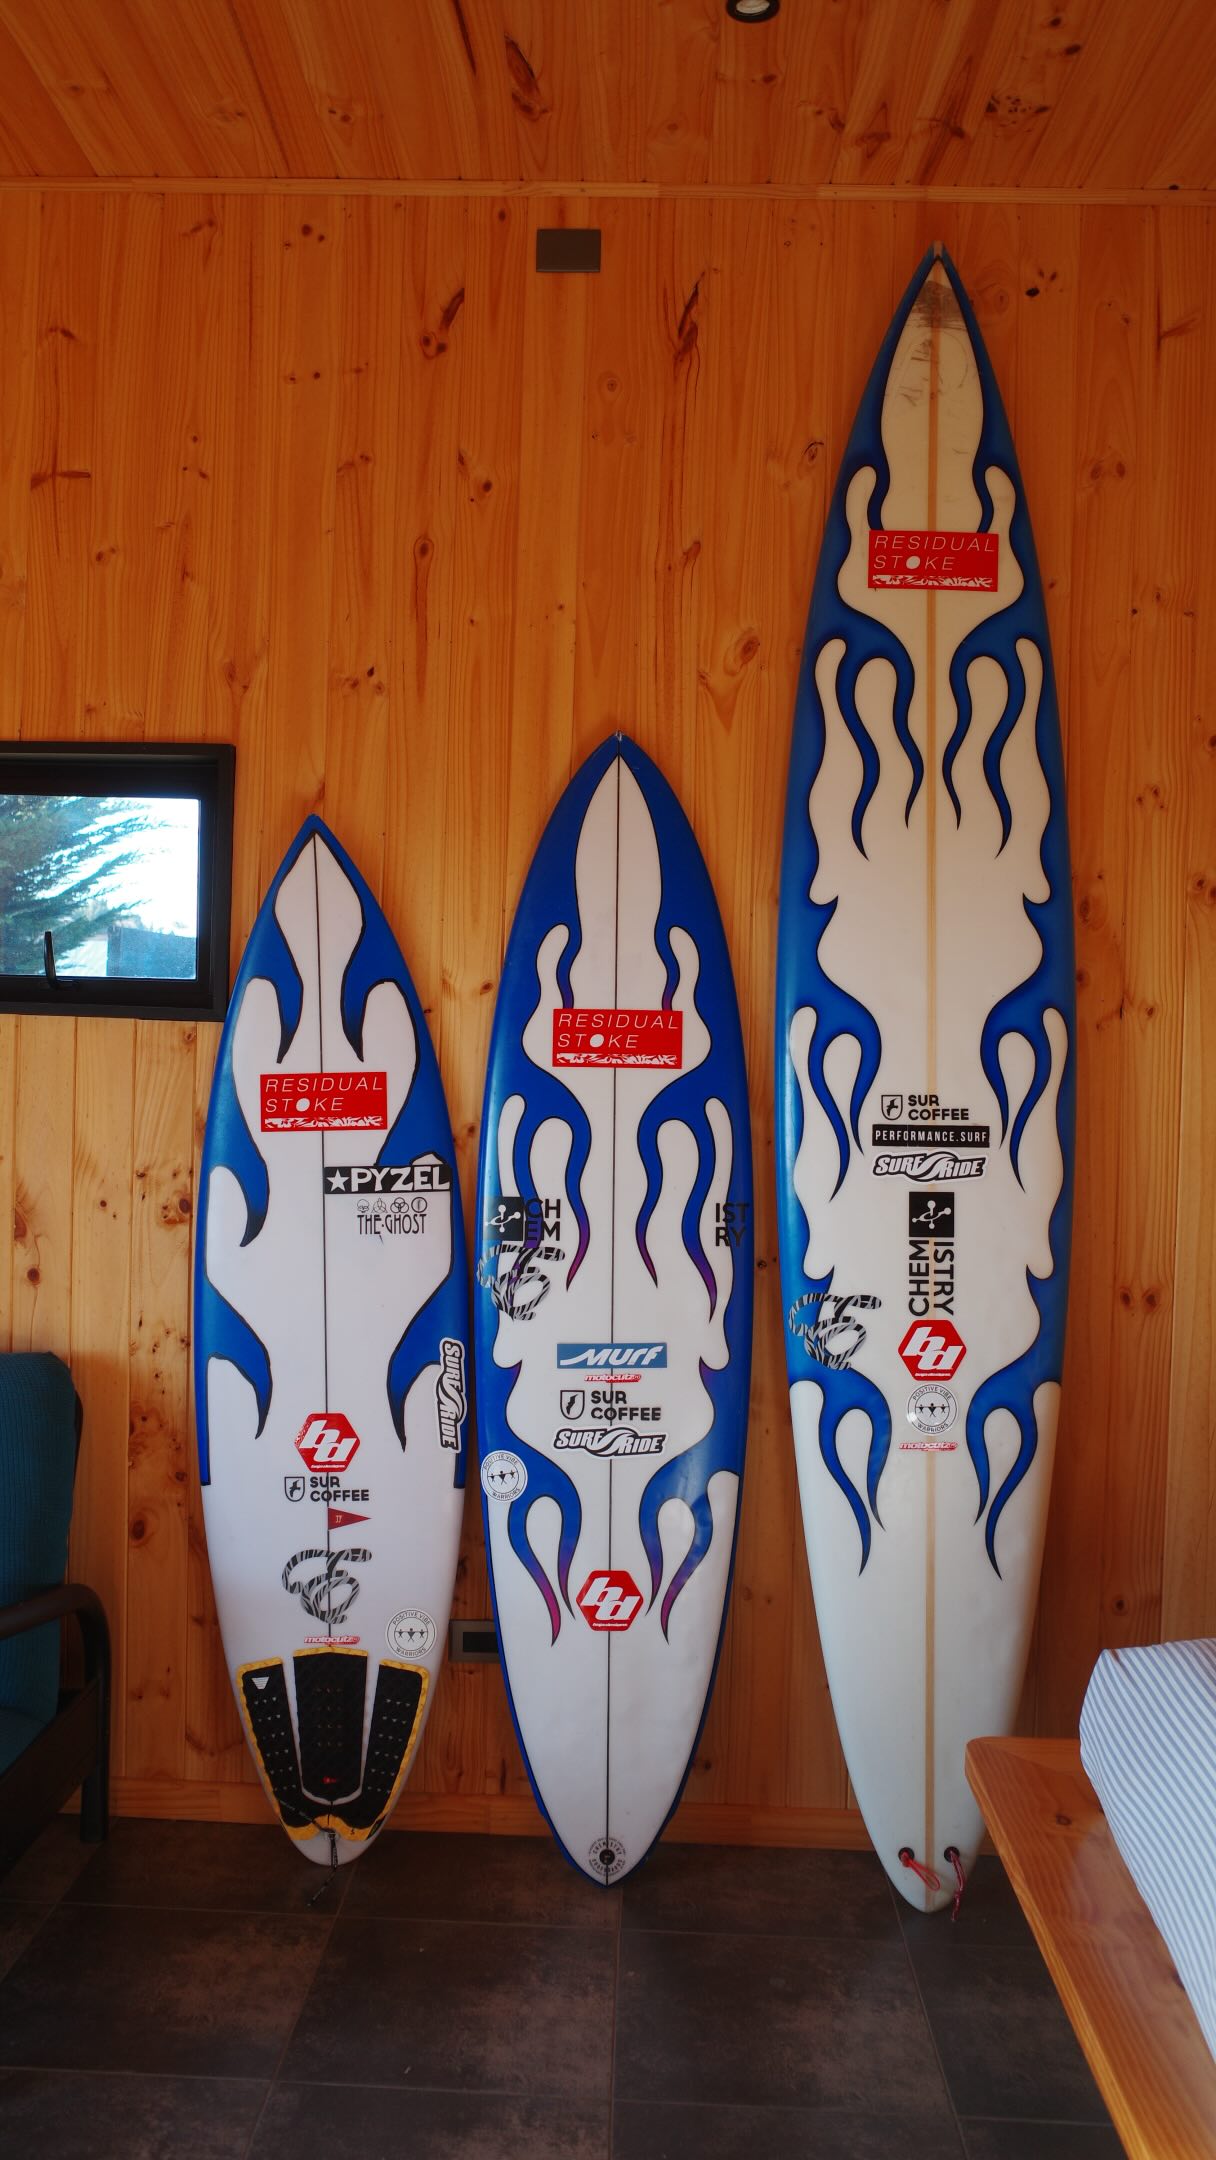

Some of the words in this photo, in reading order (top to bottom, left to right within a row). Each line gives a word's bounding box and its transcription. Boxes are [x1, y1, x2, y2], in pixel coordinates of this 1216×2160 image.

[874, 535, 994, 552] RESIDUAL
[873, 555, 955, 571] STOKE
[558, 1013, 679, 1030] RESIDUAL
[557, 1033, 640, 1049] STOKE
[265, 1076, 383, 1093] RESIDUAL
[265, 1097, 344, 1113] STOKE
[908, 1094, 939, 1107] SUR
[908, 1108, 969, 1121] COFFEE
[875, 1129, 987, 1143] PERFORMANCE.SURF
[874, 1153, 930, 1176] SURF
[937, 1156, 986, 1179] RIDE
[350, 1166, 451, 1193] PYZEL
[908, 1240, 930, 1317] CHEM
[933, 1241, 955, 1316] ISTRY
[590, 1390, 627, 1404] SUR
[590, 1407, 661, 1421] COFFEE
[555, 1429, 607, 1449] SURF
[617, 1434, 666, 1454] RIDE
[310, 1476, 341, 1488] SUR
[309, 1489, 370, 1502] COFFEE
